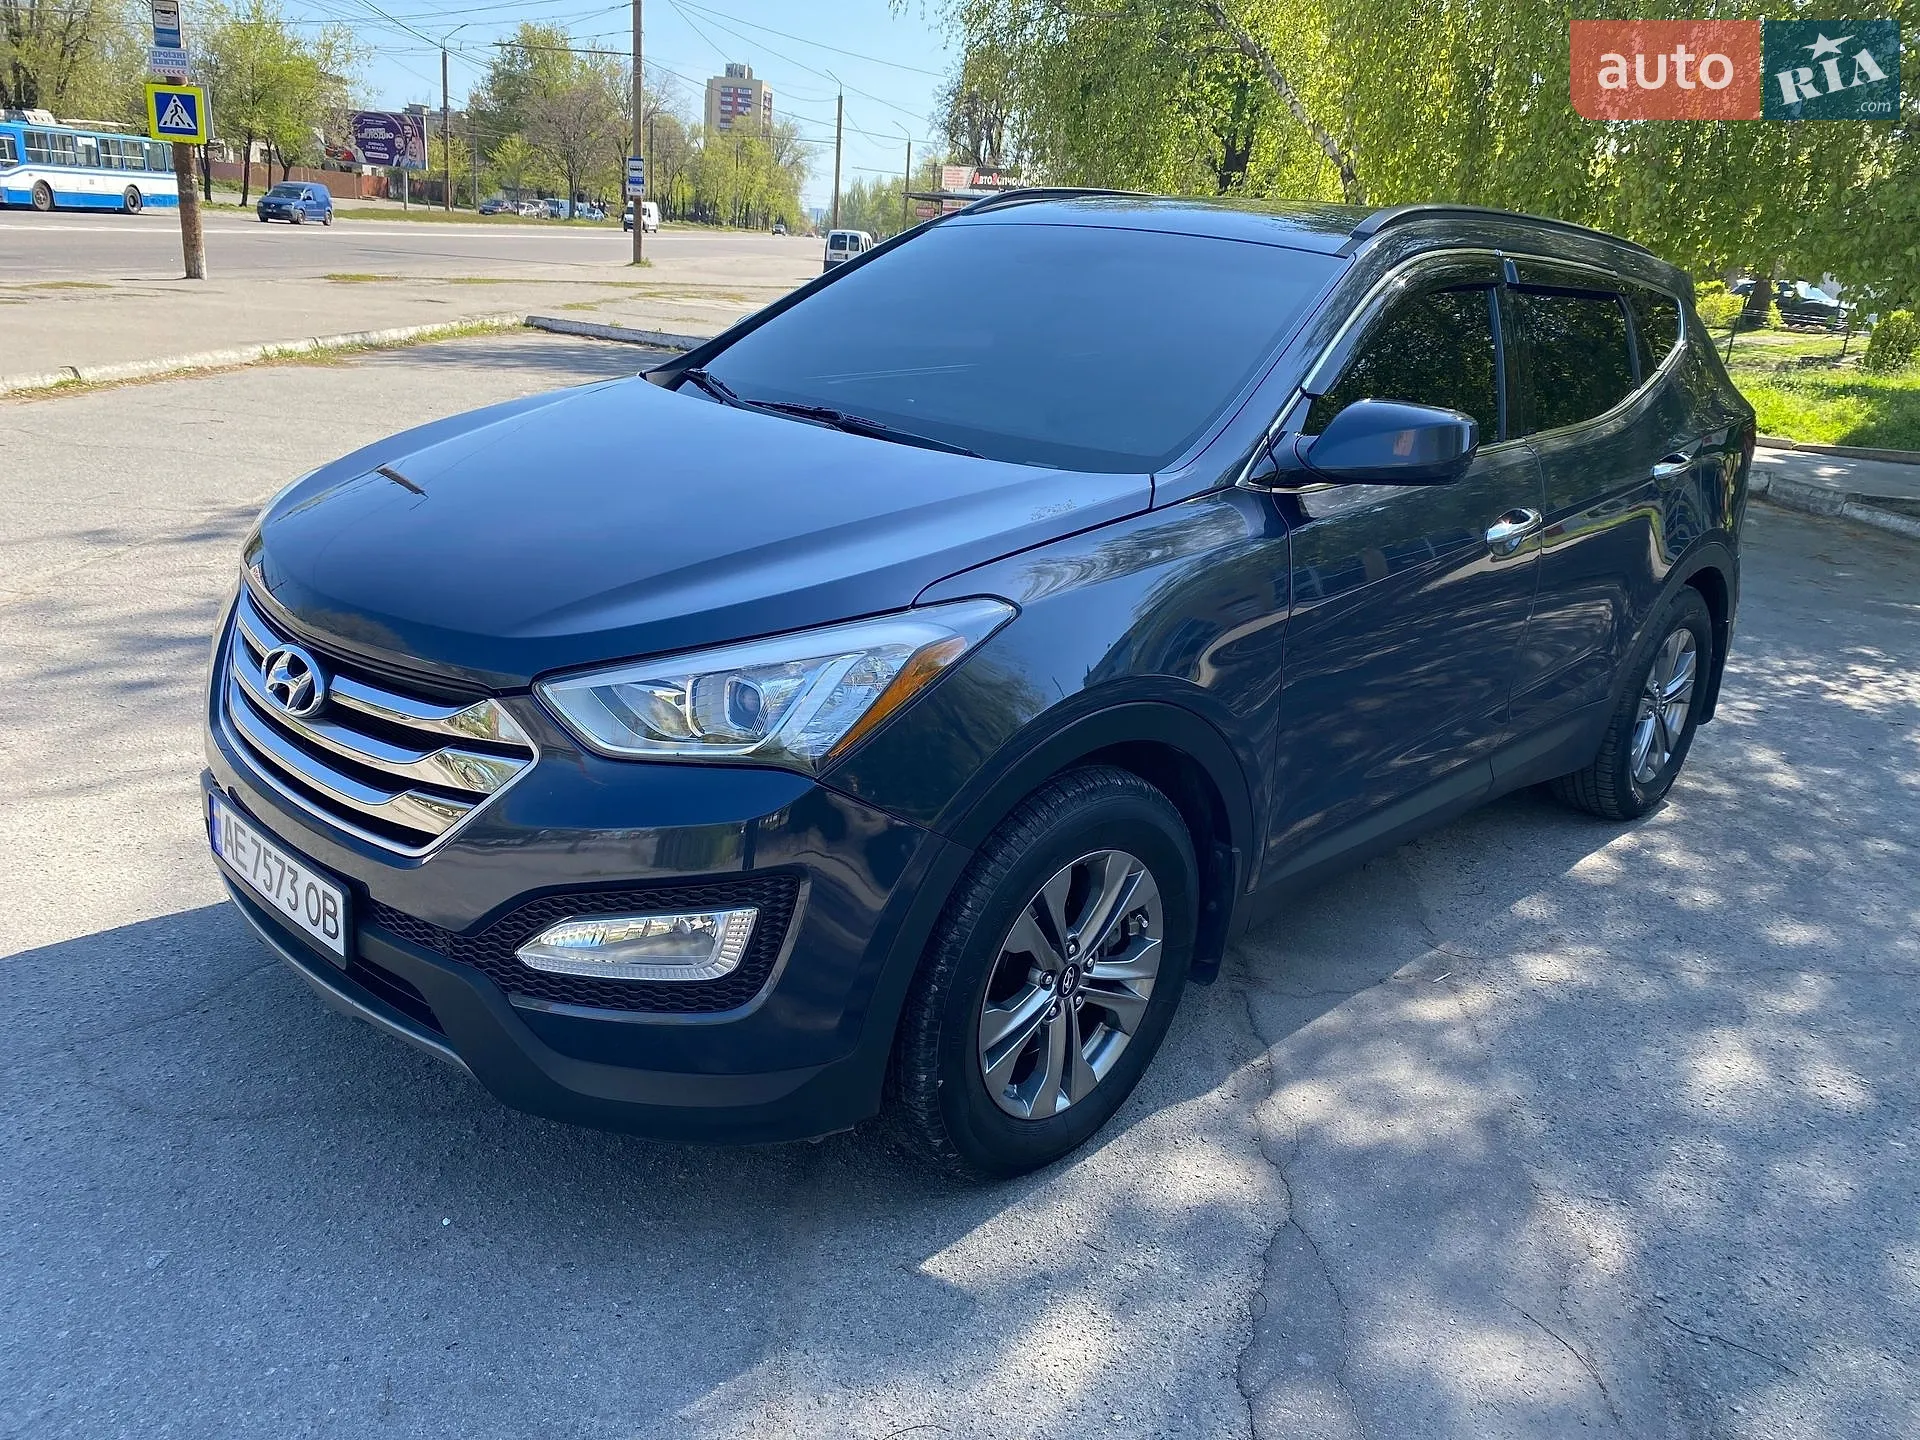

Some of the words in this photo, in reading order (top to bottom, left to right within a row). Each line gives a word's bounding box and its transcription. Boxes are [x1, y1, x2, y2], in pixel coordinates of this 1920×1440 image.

[224, 814, 247, 872] AE
[250, 837, 299, 911] 7573
[305, 881, 339, 940] OB
